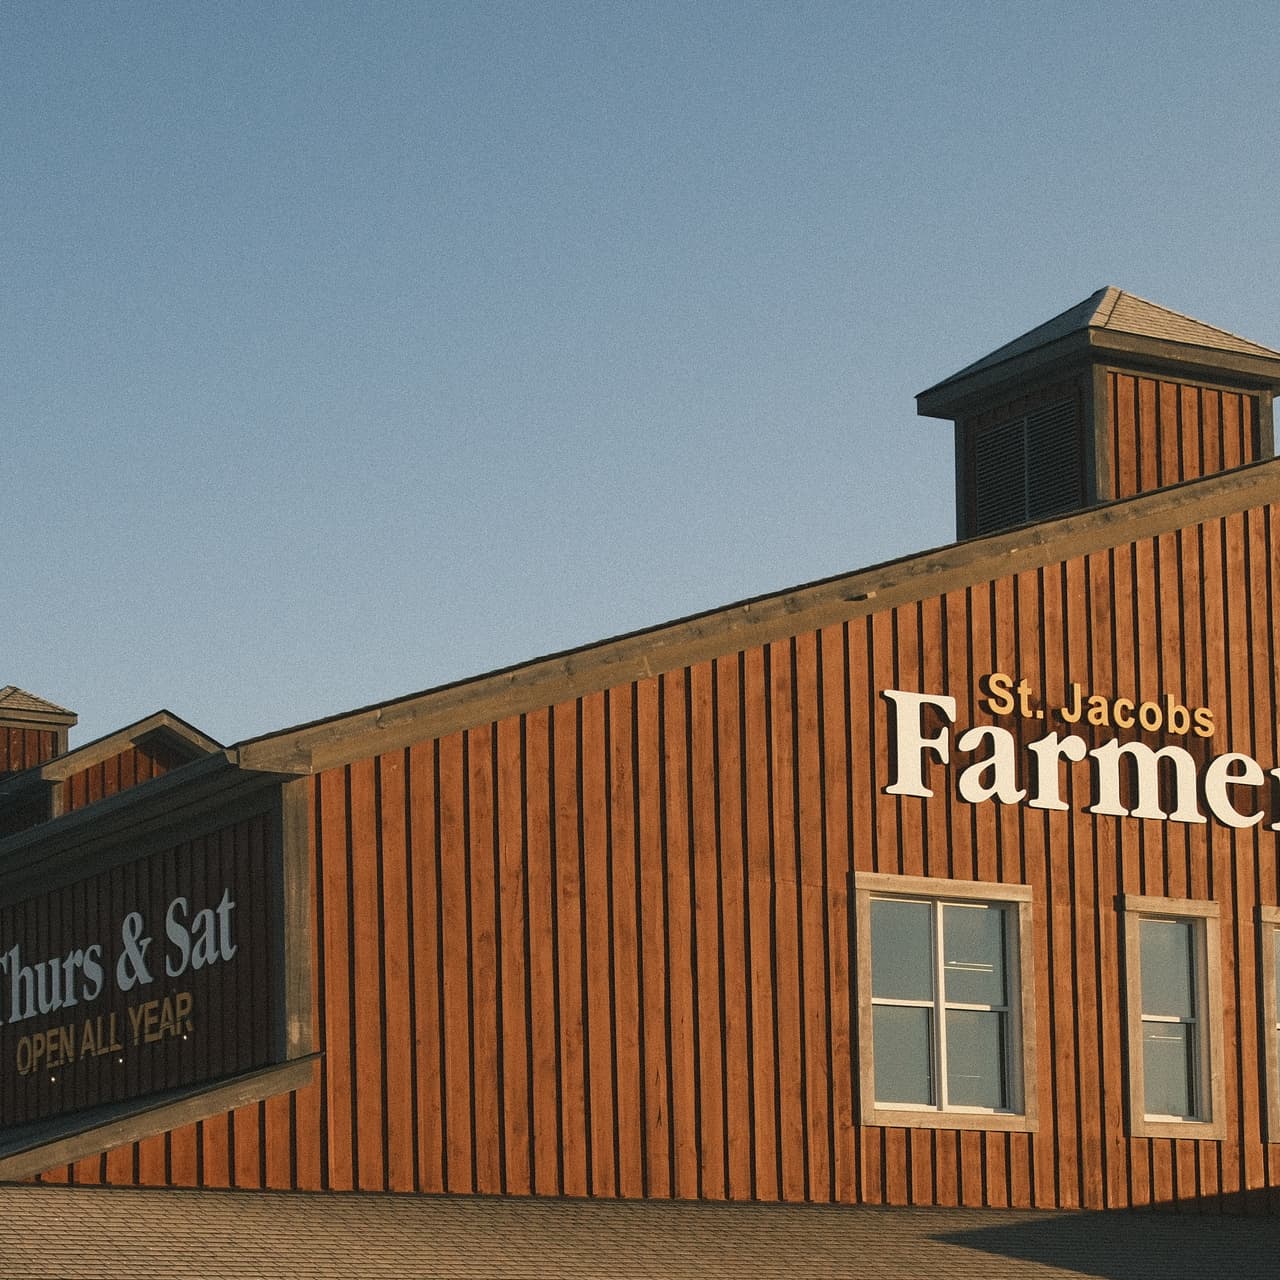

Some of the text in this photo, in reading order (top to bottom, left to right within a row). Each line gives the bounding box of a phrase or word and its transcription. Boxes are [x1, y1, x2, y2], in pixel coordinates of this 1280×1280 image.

[987, 672, 1217, 739] St. Jacobs
[116, 911, 154, 991] &
[165, 887, 238, 977] Sat
[16, 991, 194, 1076] OPEN ALL YEAR
